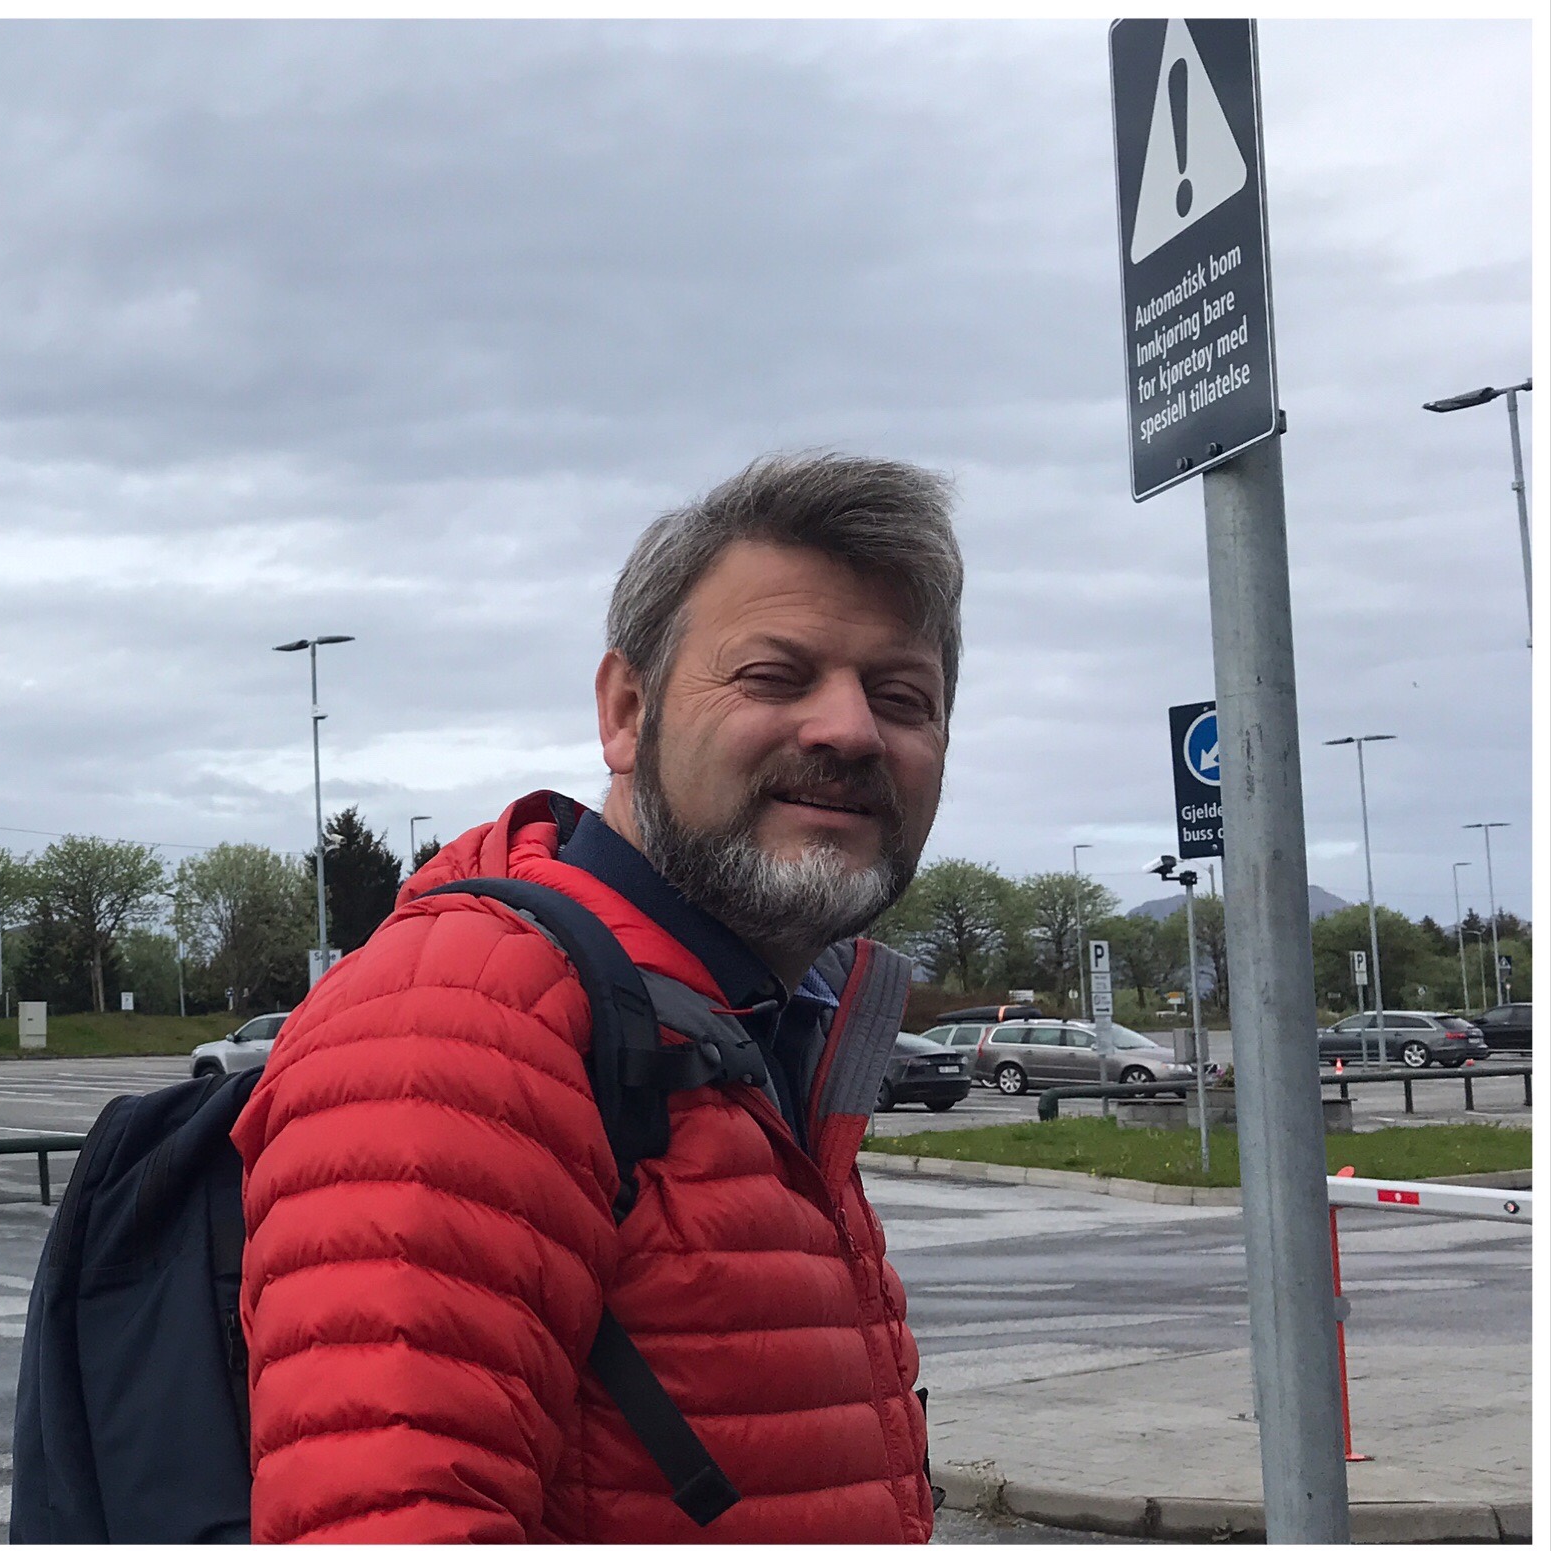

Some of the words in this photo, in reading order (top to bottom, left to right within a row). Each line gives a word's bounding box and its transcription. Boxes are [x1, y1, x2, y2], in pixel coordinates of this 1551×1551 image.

[1134, 262, 1207, 331] Automatisk
[1209, 246, 1242, 282] bom
[1136, 310, 1200, 367] Innkjøring
[1203, 290, 1235, 326] bare
[1138, 376, 1156, 403] for
[1159, 341, 1214, 395] kjøretøy
[1217, 314, 1248, 358] med
[1140, 390, 1187, 444] spesiell
[1190, 363, 1251, 414] tillatelse
[1183, 827, 1214, 842] buss
[1094, 945, 1105, 967] P
[1357, 954, 1364, 969] P
